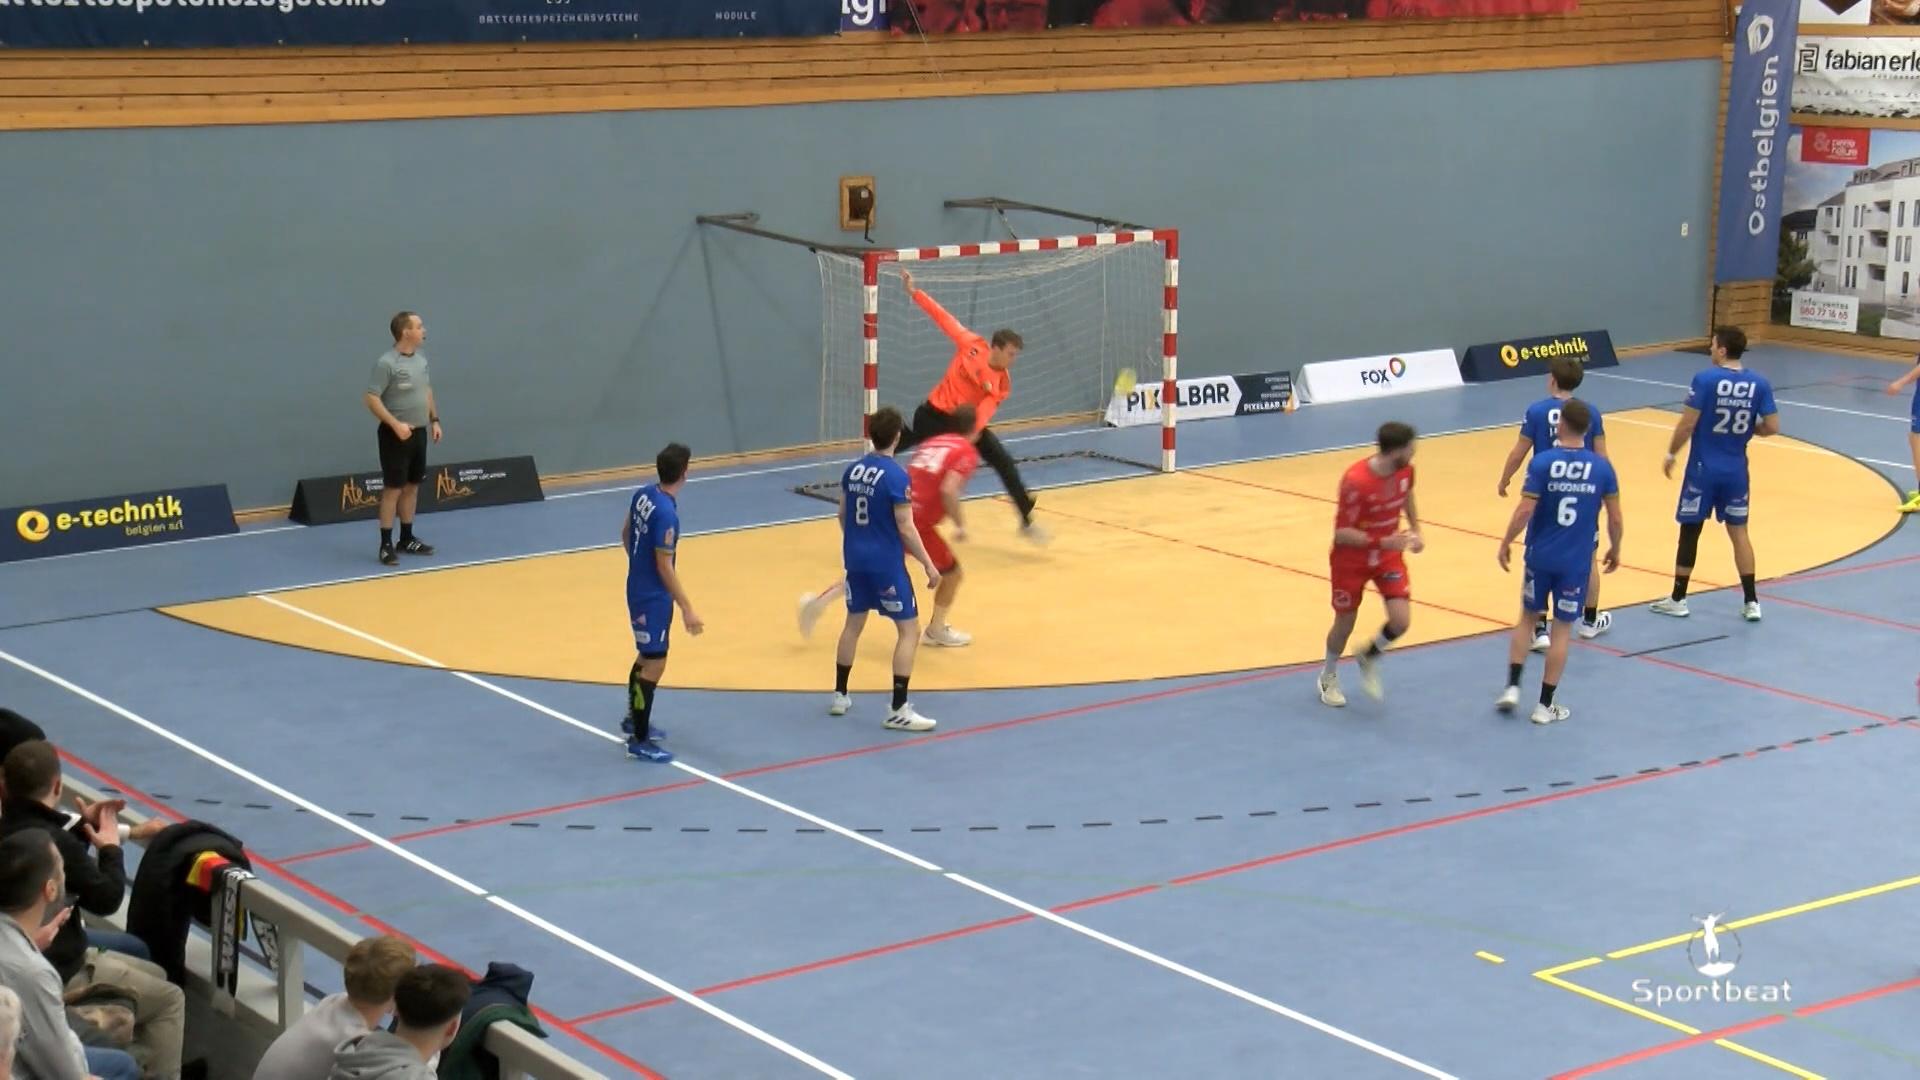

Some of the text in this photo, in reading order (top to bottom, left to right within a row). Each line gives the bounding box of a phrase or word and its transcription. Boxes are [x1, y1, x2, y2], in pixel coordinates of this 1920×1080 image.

[1825, 49, 1887, 71] fabian
[1748, 55, 1780, 236] Ostbelgien
[1520, 337, 1589, 361] e-technik
[1360, 369, 1391, 386] FOX
[1716, 378, 1757, 398] OCI
[1126, 382, 1230, 412] PIXLBAR
[1712, 407, 1751, 435] 28
[850, 462, 885, 487] OCI
[1550, 459, 1593, 481] OCI
[56, 494, 184, 531] e-technik
[635, 493, 657, 522] OCI
[855, 495, 870, 526] 8
[1556, 495, 1579, 528] 6
